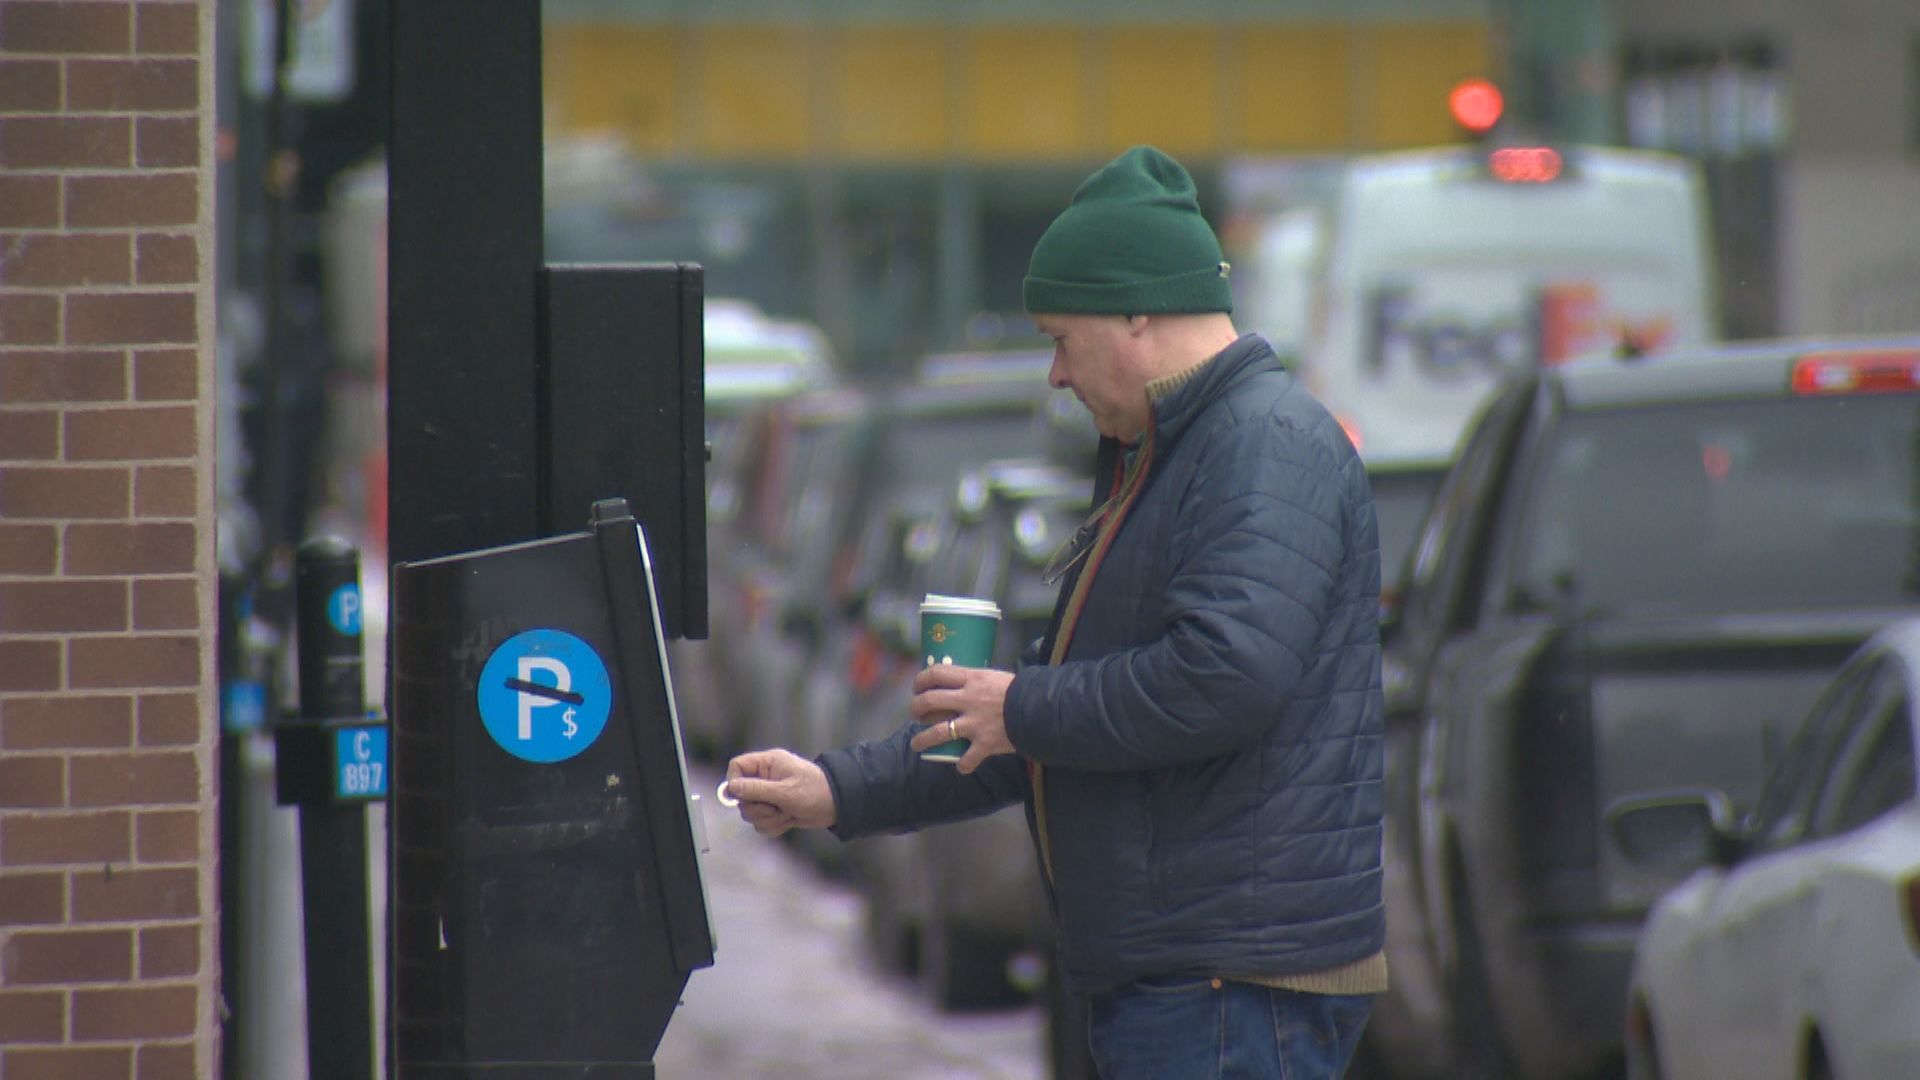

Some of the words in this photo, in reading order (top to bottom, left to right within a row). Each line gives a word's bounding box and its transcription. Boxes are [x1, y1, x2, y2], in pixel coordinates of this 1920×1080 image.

[342, 591, 360, 628] P
[518, 656, 572, 740] P
[353, 730, 371, 760] C
[345, 762, 383, 792] 897
